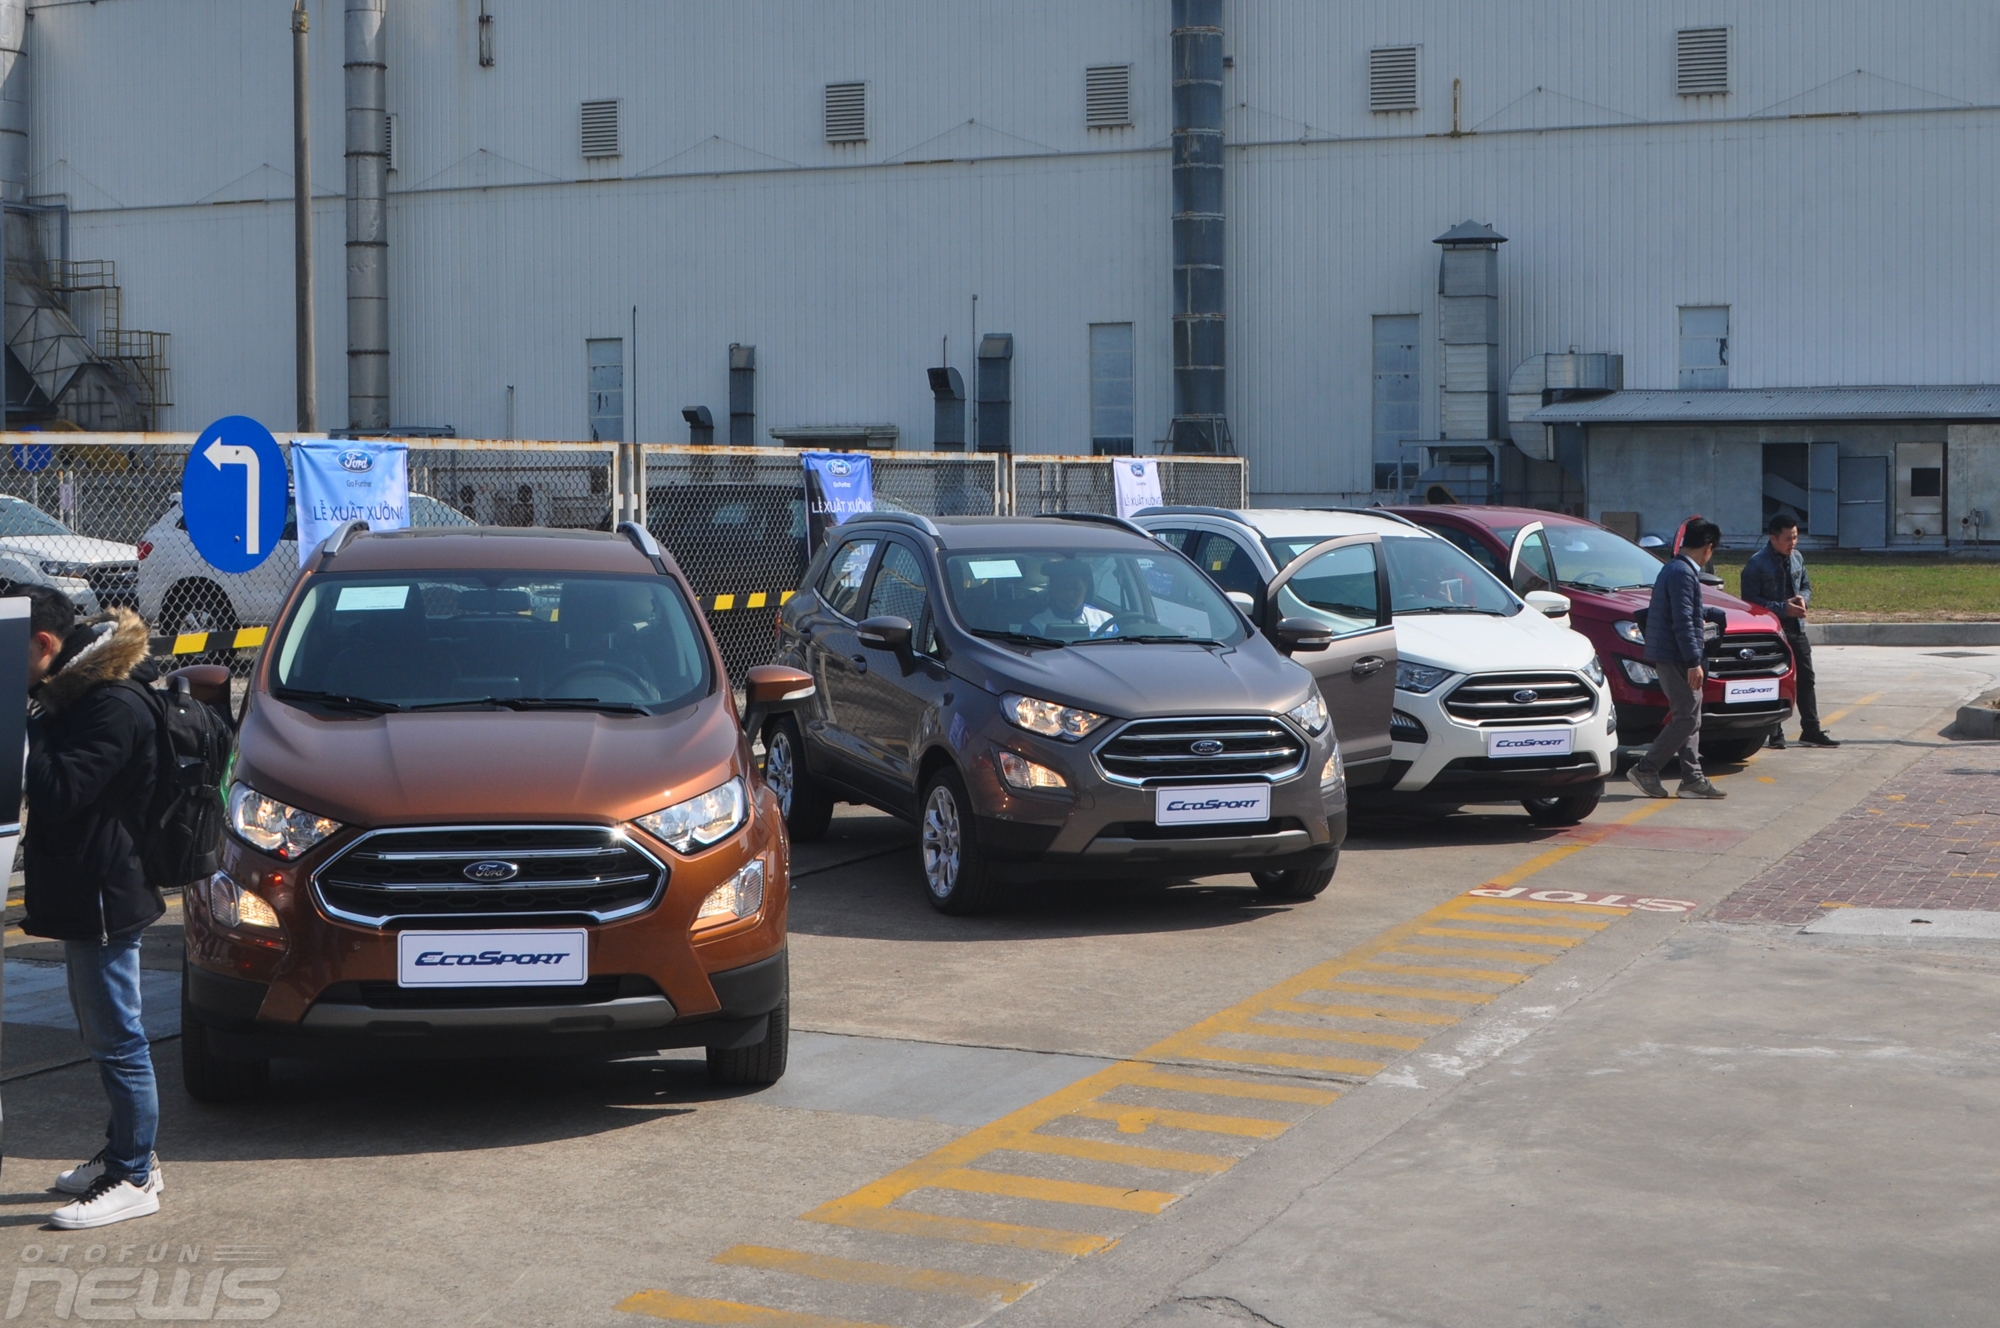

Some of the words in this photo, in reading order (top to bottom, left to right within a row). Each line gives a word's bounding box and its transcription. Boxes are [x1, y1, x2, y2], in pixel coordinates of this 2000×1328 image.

[344, 451, 369, 469] Ford
[313, 499, 328, 521] LỄ
[330, 500, 364, 521] XUẤT
[475, 863, 505, 877] Ford
[1468, 886, 1697, 913] STOP
